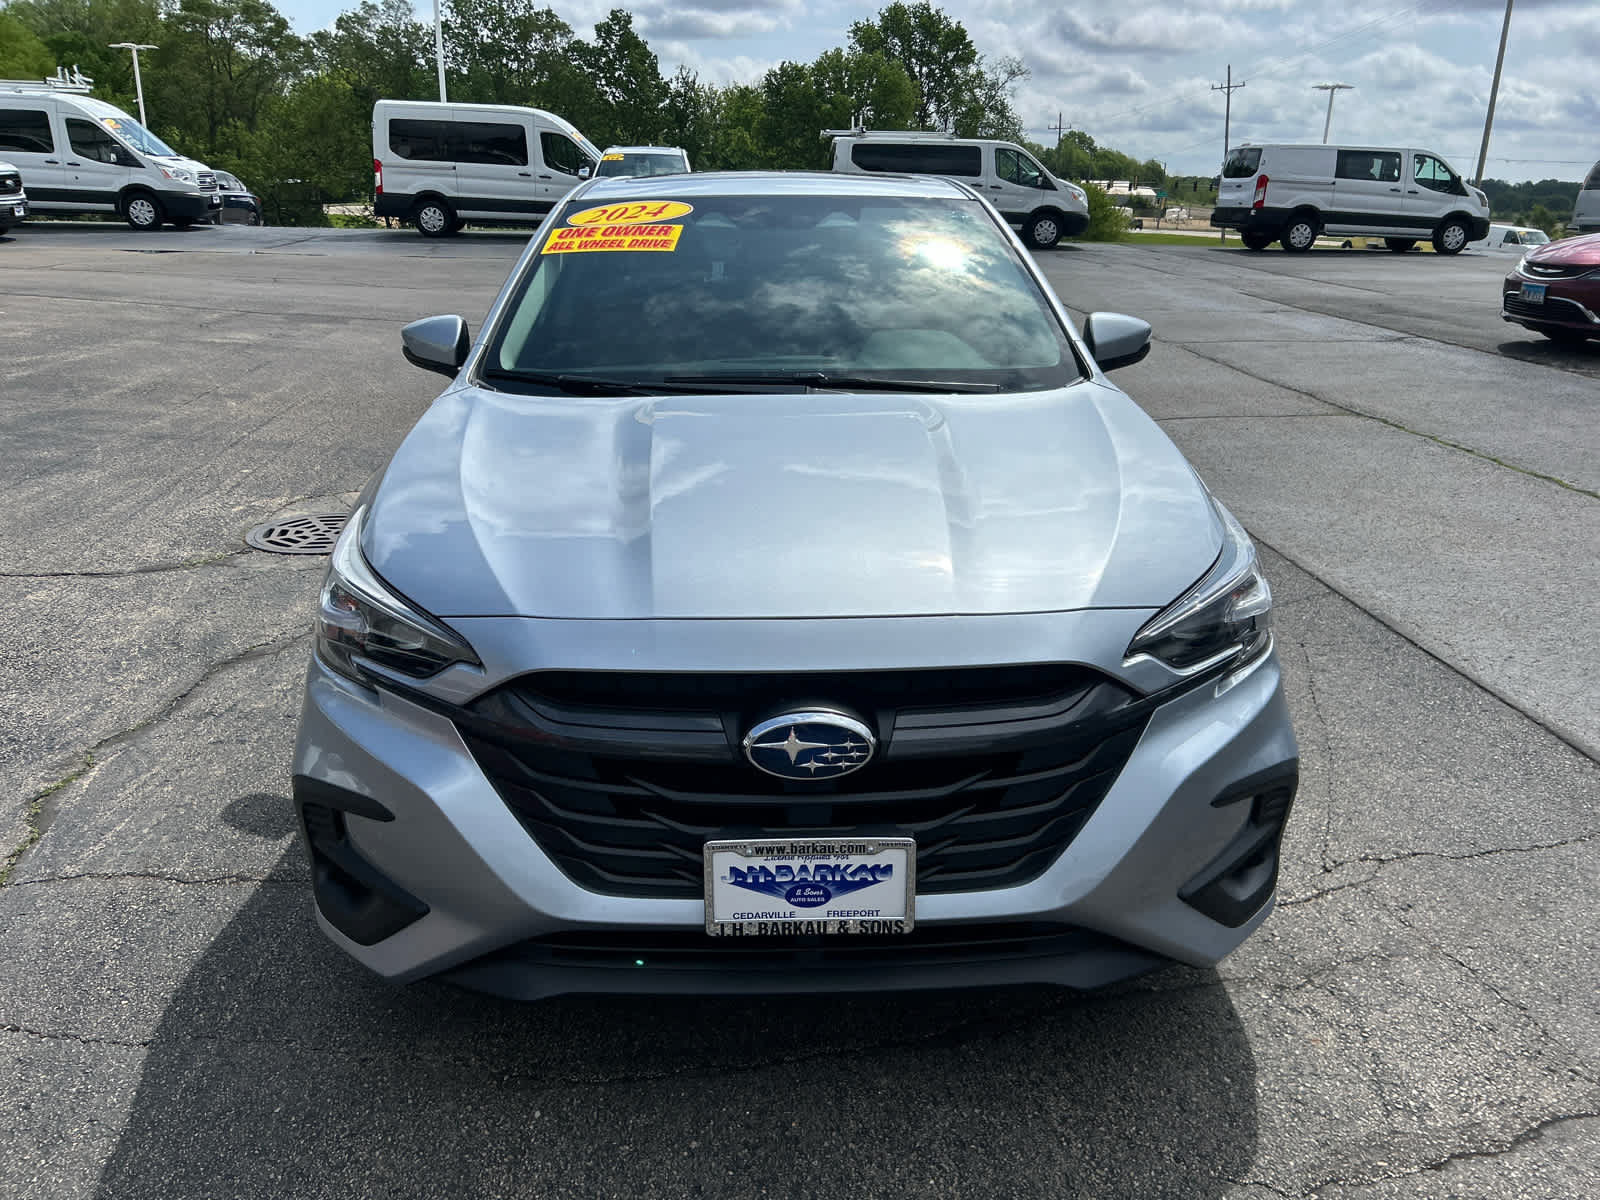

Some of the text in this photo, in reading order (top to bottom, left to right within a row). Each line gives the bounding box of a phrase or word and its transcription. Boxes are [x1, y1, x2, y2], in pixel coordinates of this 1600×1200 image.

[584, 203, 671, 224] 2024
[557, 226, 673, 239] ONE OWNER
[547, 239, 674, 251] ALL WHEEL DRIVE
[754, 843, 866, 855] www.barkau.com
[732, 910, 881, 920] CEDARVILLE FREEPORT
[760, 921, 828, 936] BARKAU
[838, 920, 850, 935] &
[860, 919, 904, 935] SONS
